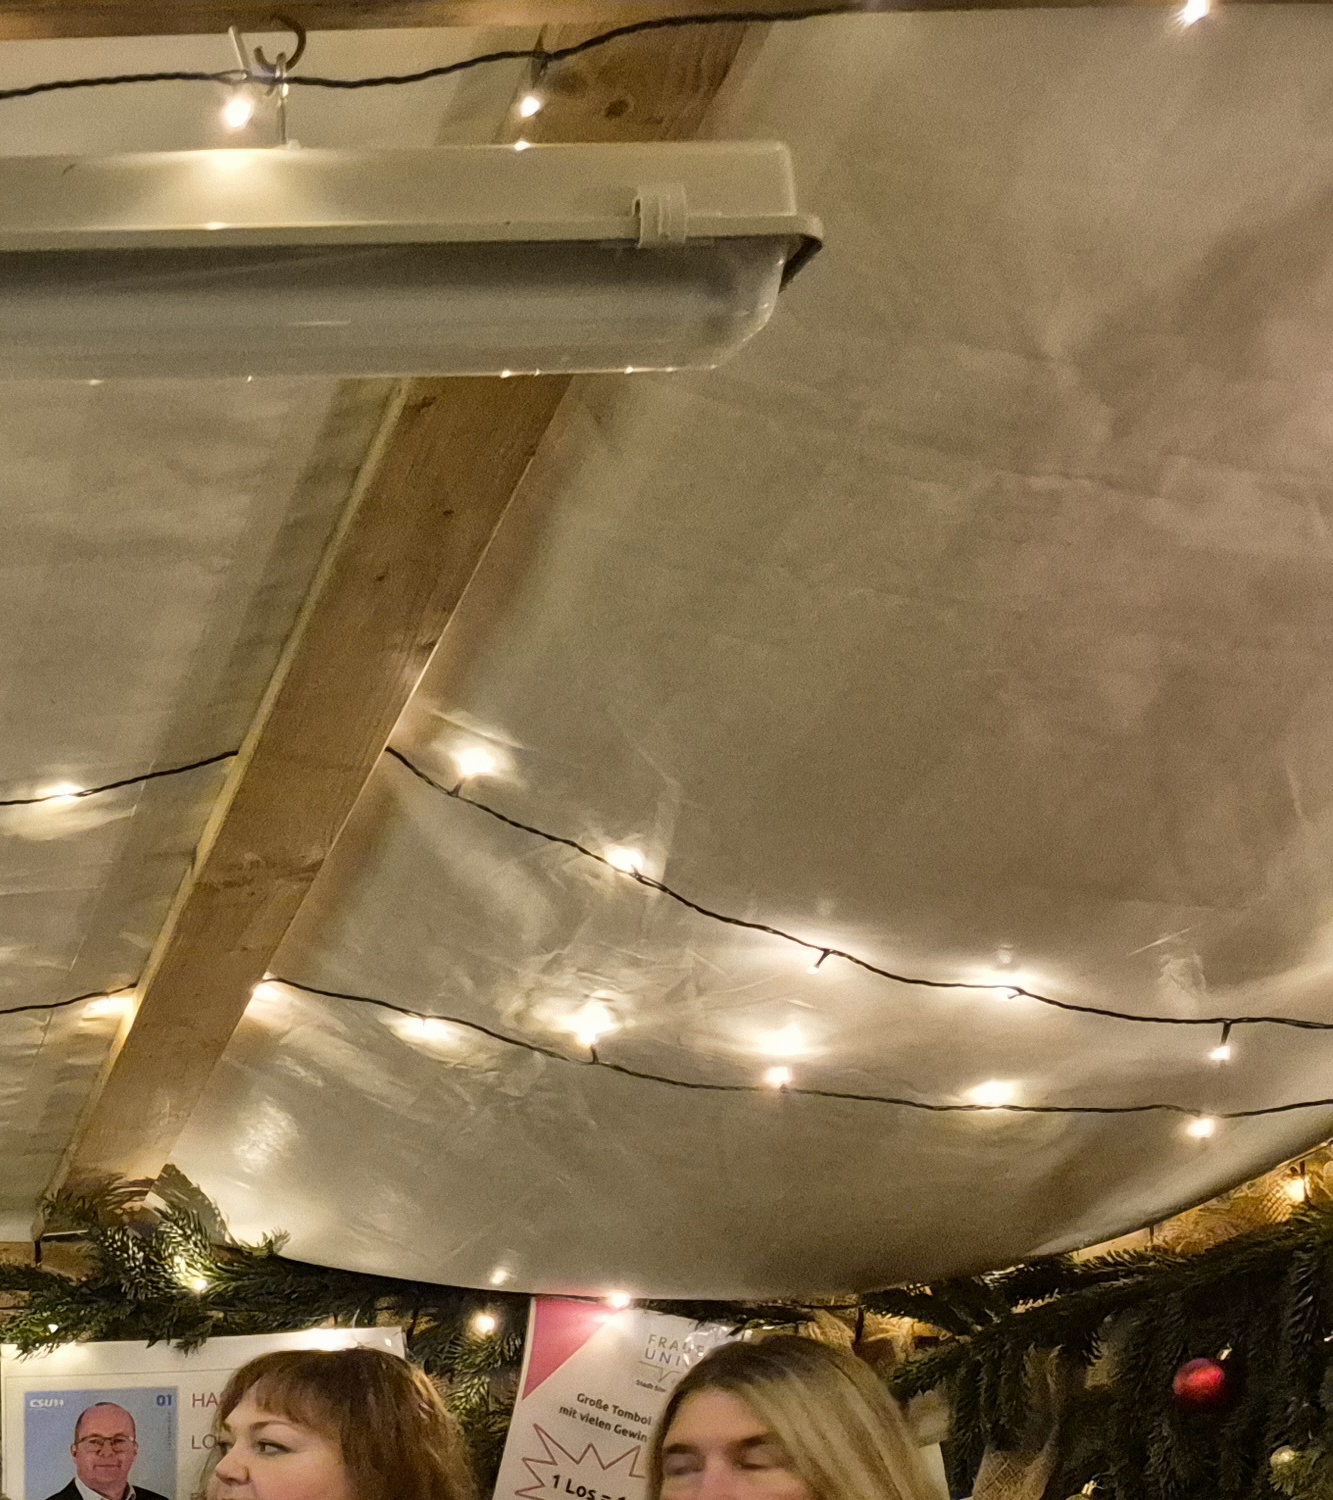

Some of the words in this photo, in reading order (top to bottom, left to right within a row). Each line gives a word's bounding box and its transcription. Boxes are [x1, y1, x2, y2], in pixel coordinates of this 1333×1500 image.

[648, 1333, 704, 1355] FRAUE
[645, 1348, 680, 1366] UNI
[156, 1394, 172, 1407] 01
[577, 1393, 609, 1412] Große
[612, 1404, 652, 1425] Tombol
[559, 1406, 577, 1419] mit
[580, 1413, 611, 1431] vielen
[614, 1424, 647, 1443] Gewin
[551, 1474, 560, 1489] 1
